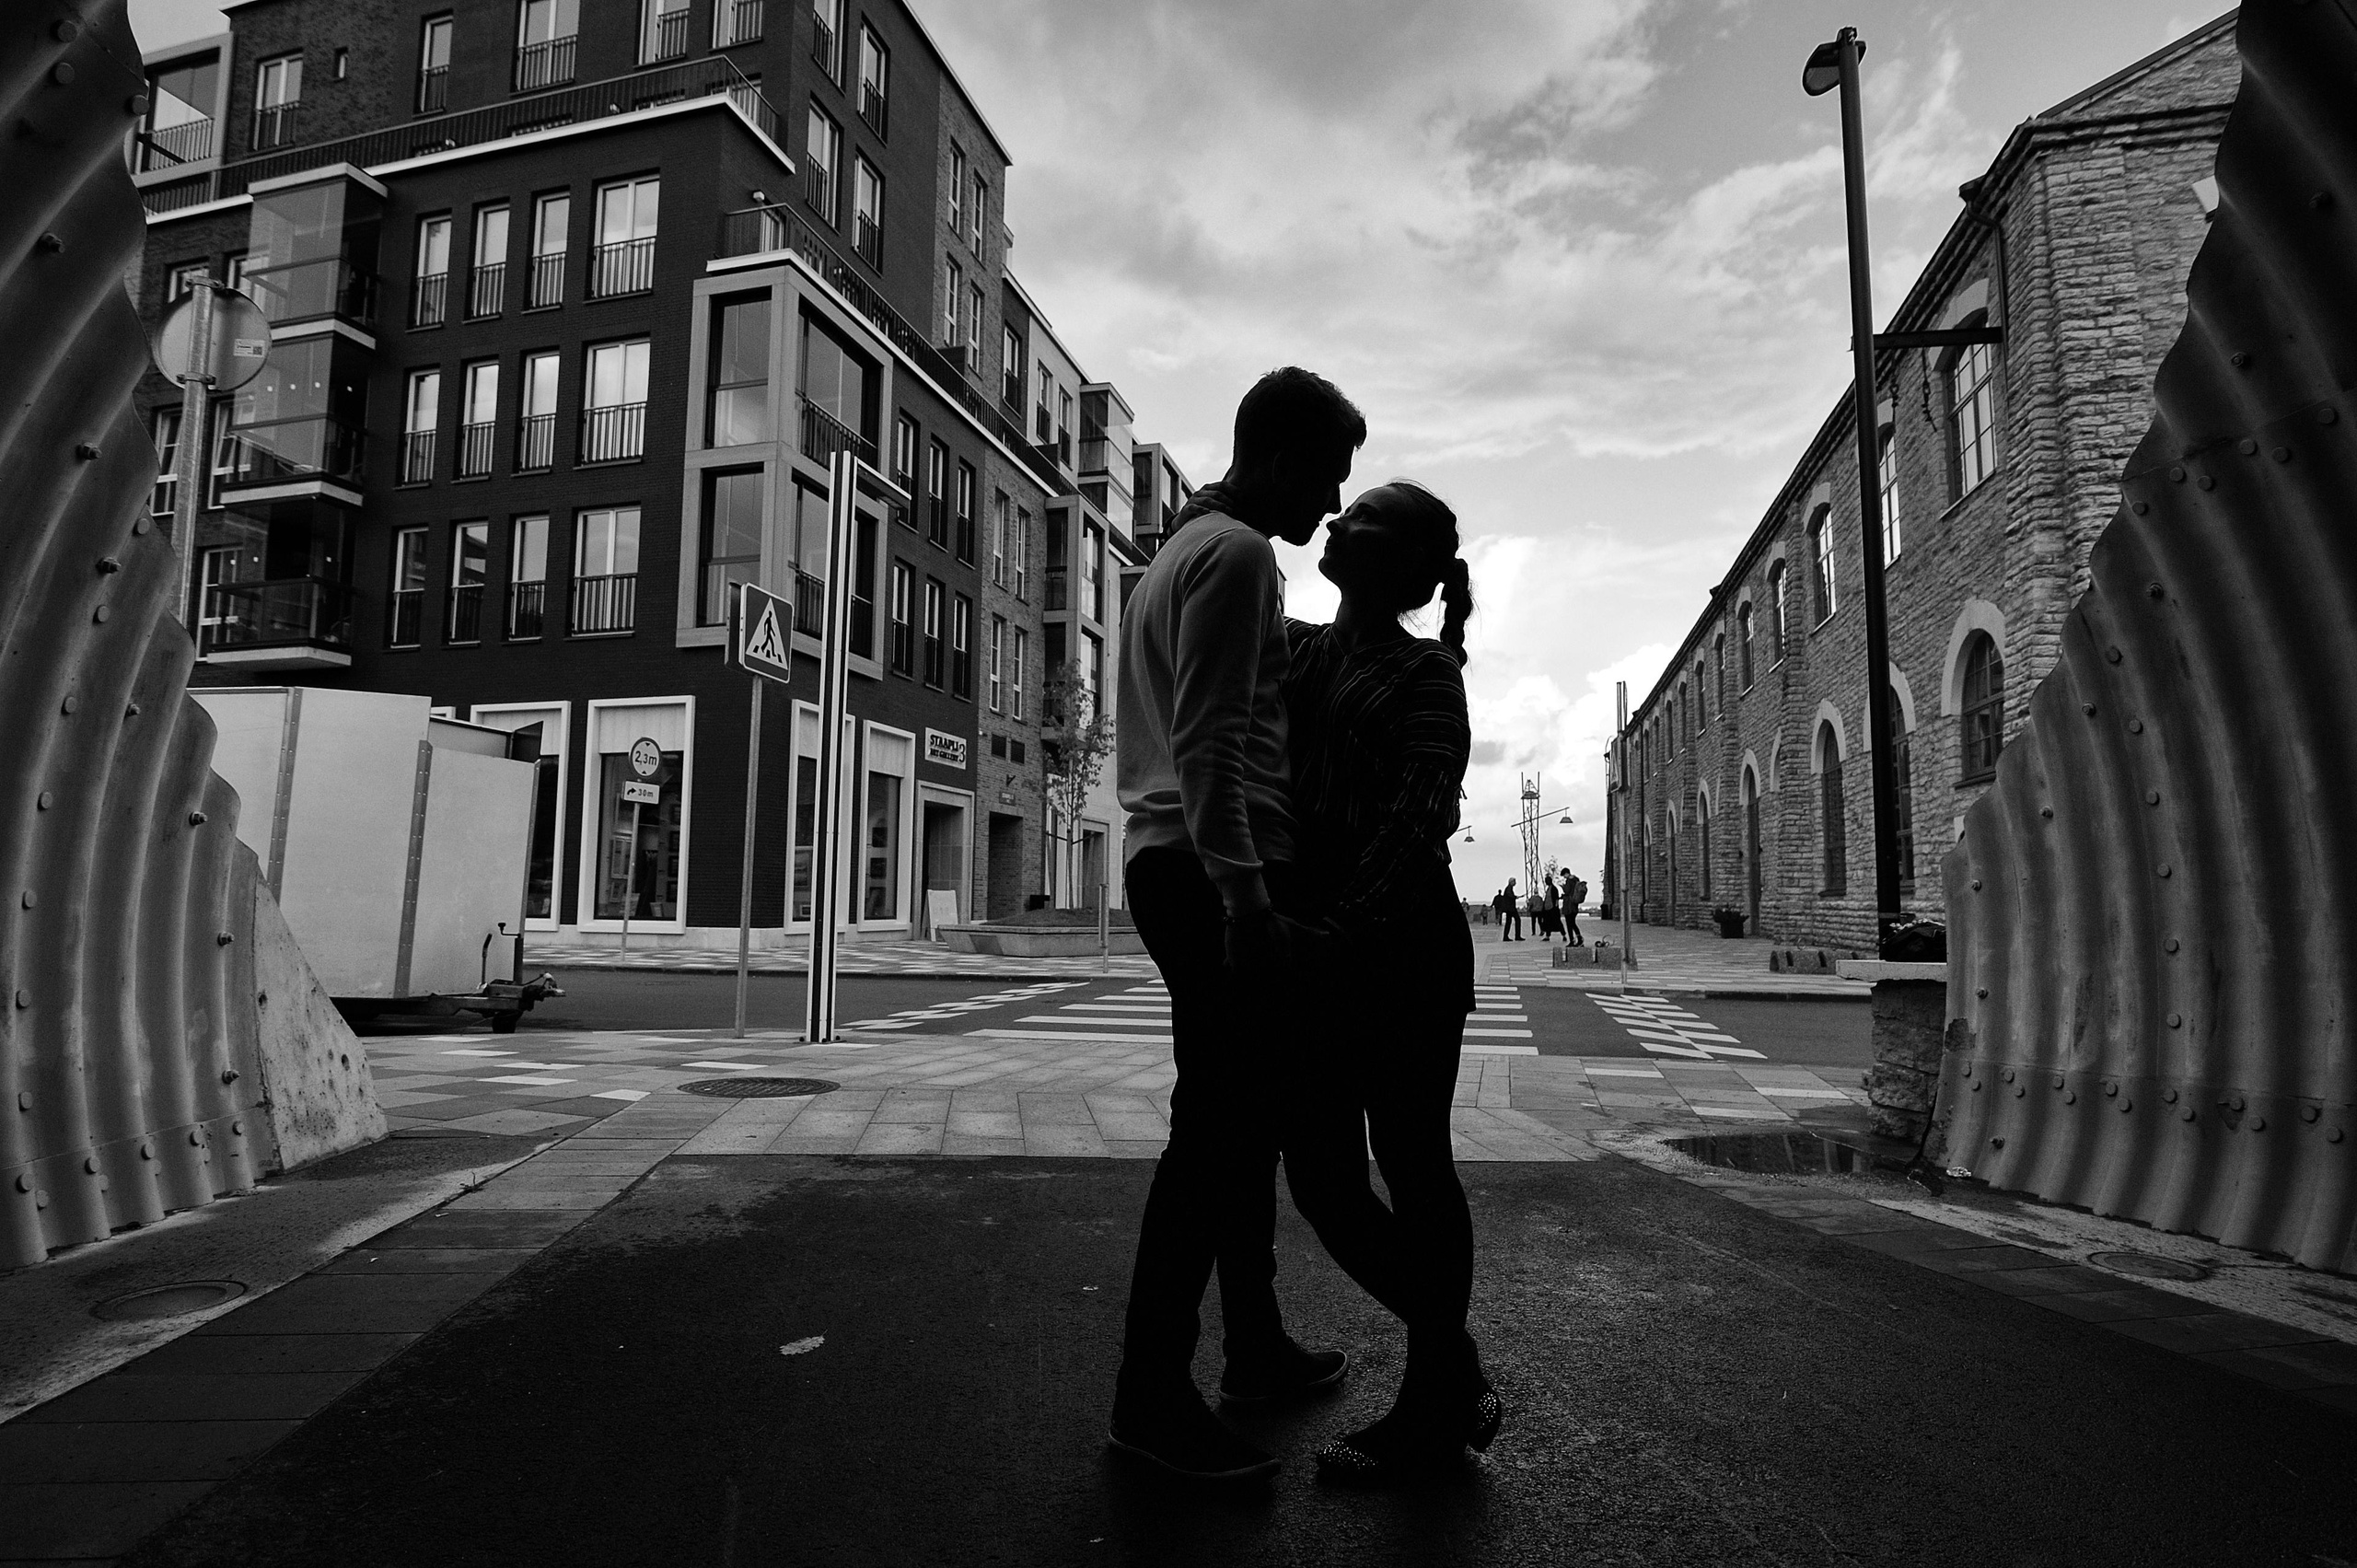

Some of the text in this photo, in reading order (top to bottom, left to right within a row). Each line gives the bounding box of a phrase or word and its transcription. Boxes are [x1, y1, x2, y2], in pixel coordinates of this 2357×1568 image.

[634, 750, 657, 766] 2,3m
[959, 743, 965, 762] 3
[638, 788, 654, 797] 30m
